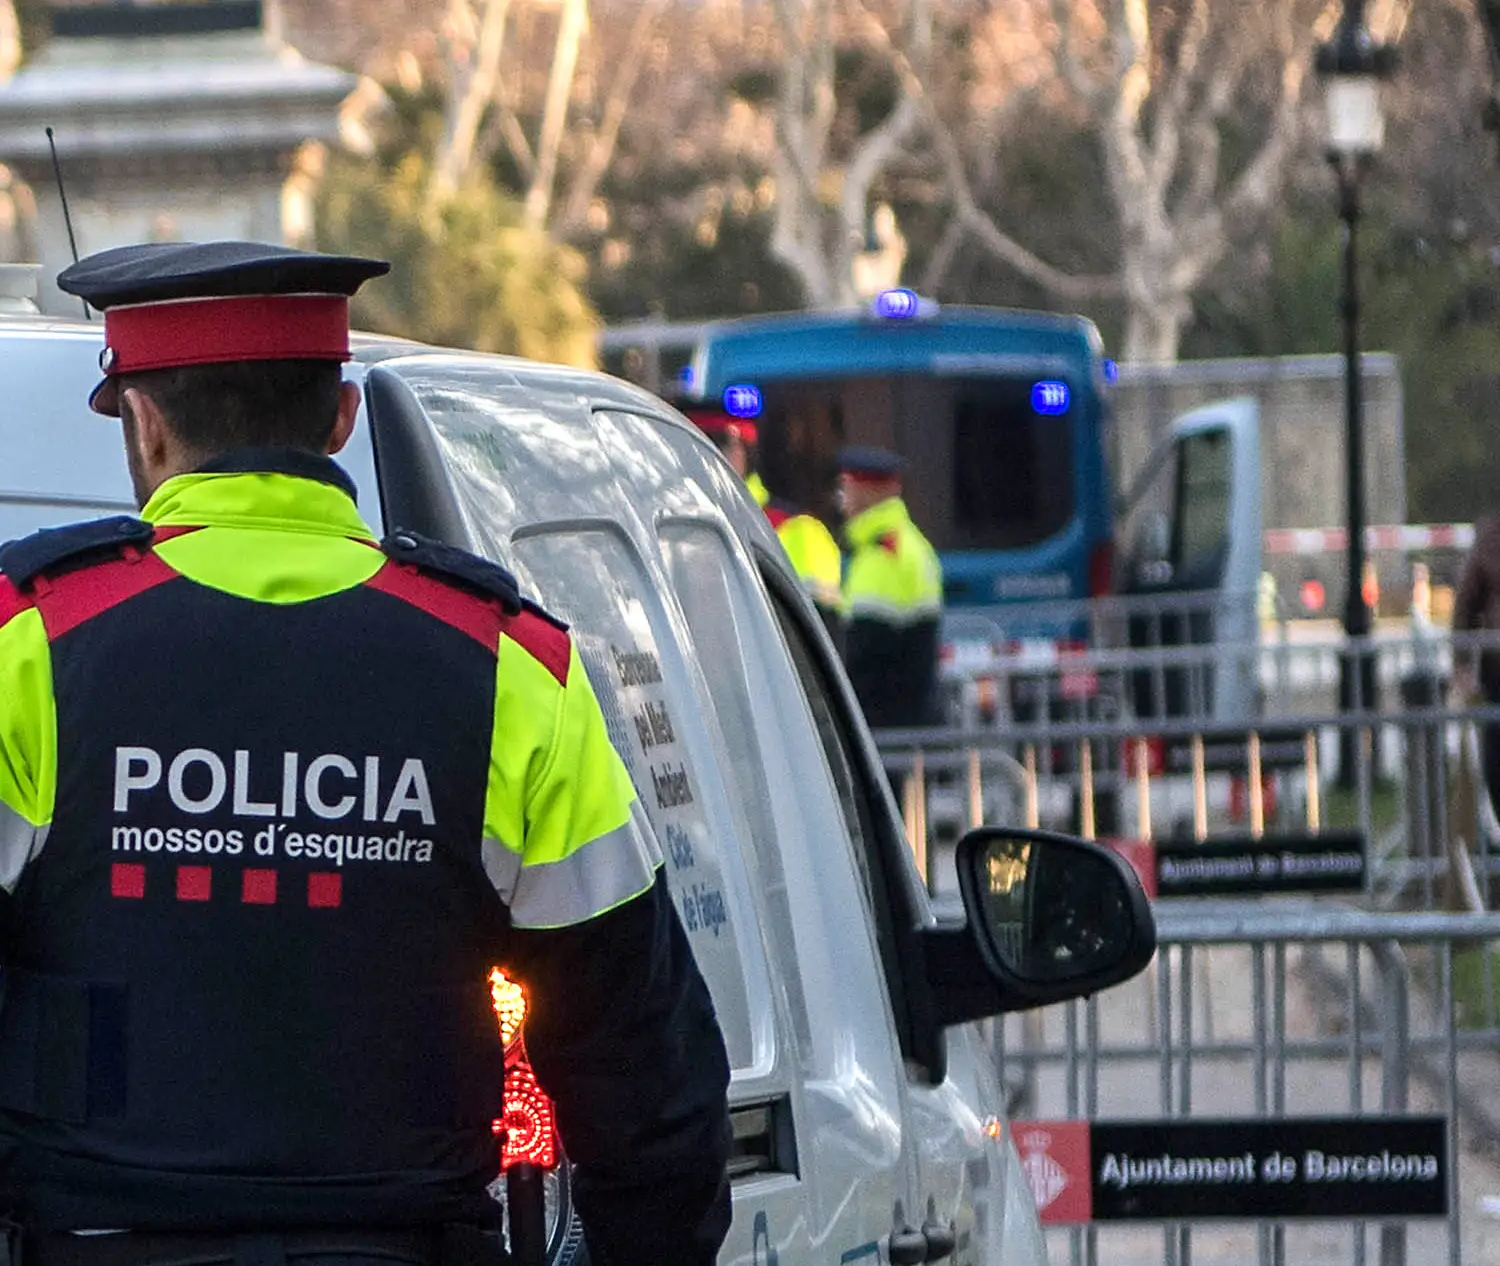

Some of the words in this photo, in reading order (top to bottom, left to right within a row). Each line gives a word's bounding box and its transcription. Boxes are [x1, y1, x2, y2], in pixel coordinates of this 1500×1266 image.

[113, 746, 437, 825] POLICIA
[111, 826, 244, 854] mossos
[1102, 1152, 1256, 1190] Ajuntament
[1262, 1151, 1298, 1183] de
[1305, 1150, 1439, 1182] Barcelona
